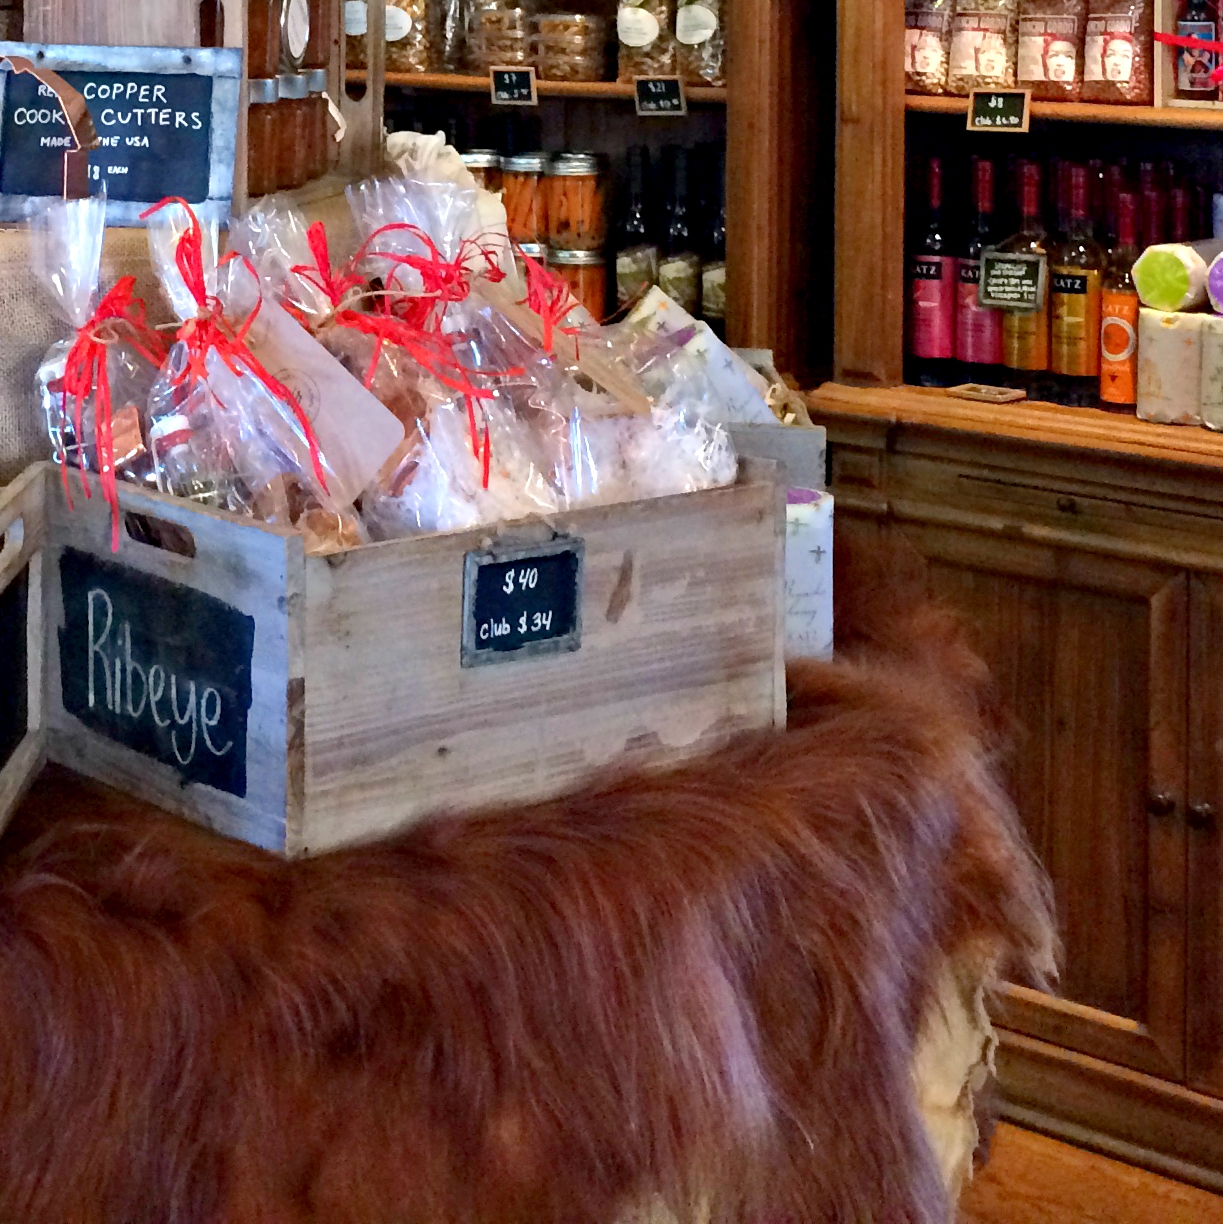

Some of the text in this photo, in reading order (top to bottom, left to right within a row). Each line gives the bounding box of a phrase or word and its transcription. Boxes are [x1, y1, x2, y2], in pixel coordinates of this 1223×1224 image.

[83, 82, 167, 103] COPPER
[101, 108, 202, 130] CUTTERS
[40, 136, 71, 147] MADE
[126, 136, 149, 148] USA
[107, 166, 128, 174] EACH
[503, 567, 538, 594] $40
[480, 610, 552, 639] club $34
[87, 588, 233, 765] Ribeye
